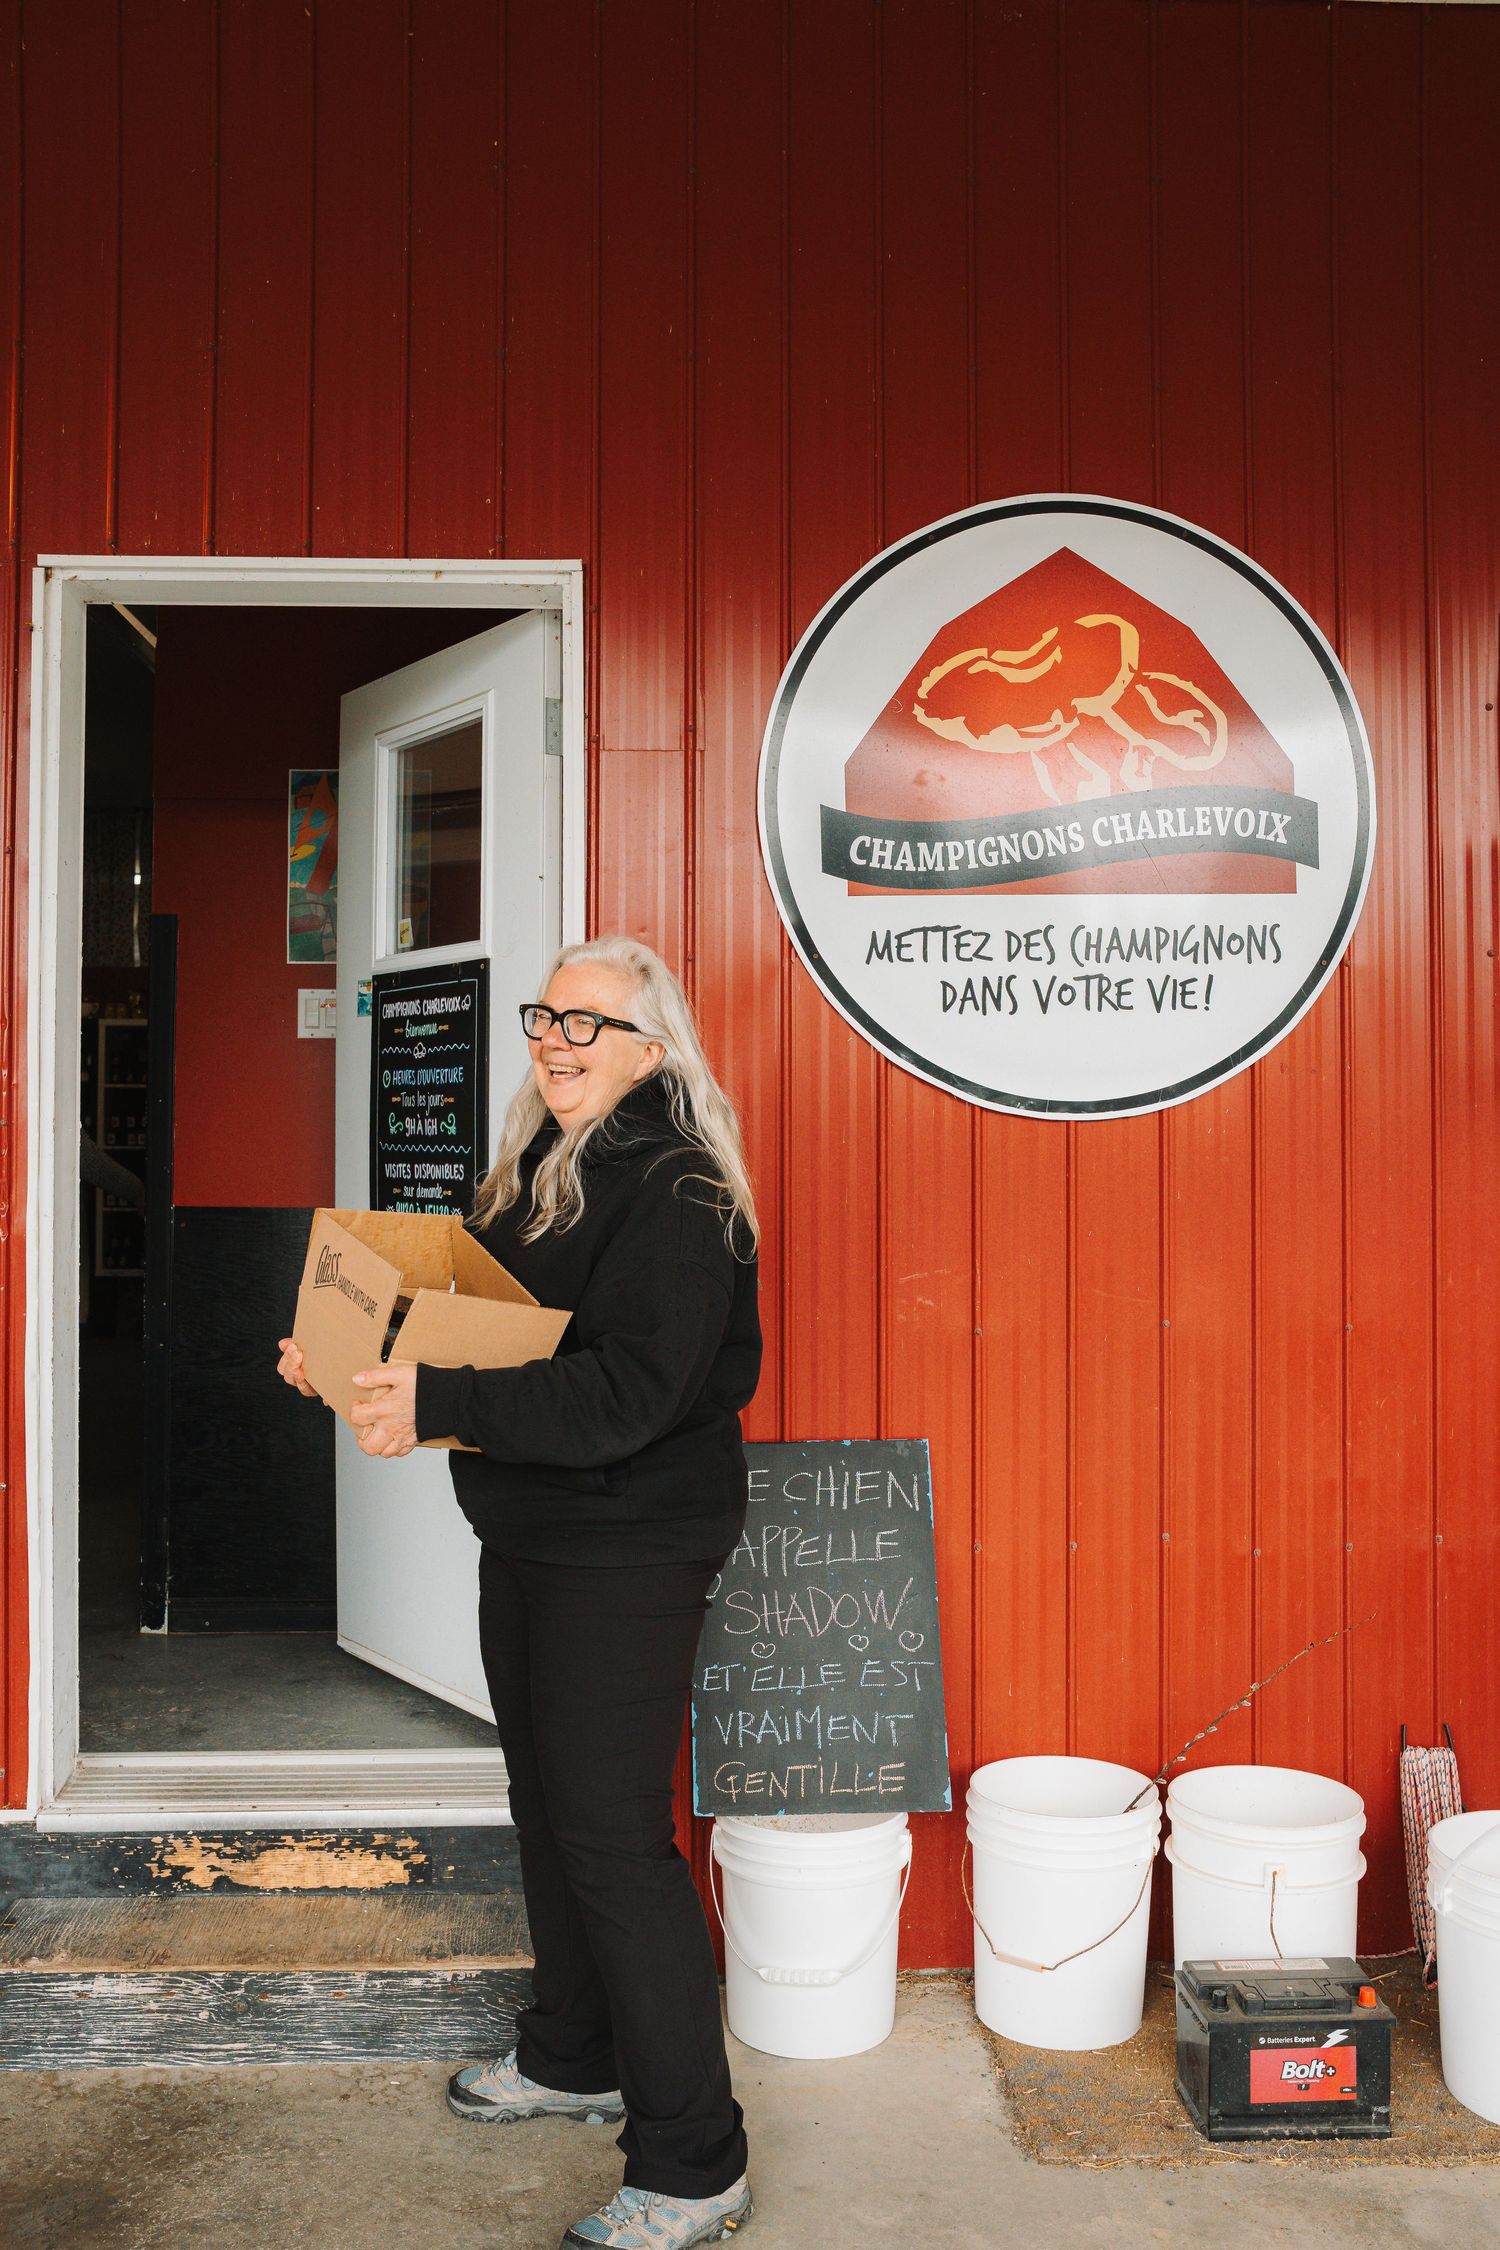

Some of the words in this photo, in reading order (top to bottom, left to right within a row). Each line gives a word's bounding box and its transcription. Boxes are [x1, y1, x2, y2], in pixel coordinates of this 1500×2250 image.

[848, 821, 1085, 872] CHAMPIGNONS
[1091, 806, 1292, 847] CHARLEVOIX
[865, 924, 994, 965] METTEZ
[1005, 924, 1057, 965] DES
[1069, 923, 1283, 967] CHAMPIGNONS
[382, 1000, 421, 1019] CHAMPIGNONS
[422, 996, 461, 1016] CHARLEVOIX
[939, 973, 1018, 1015] DANS
[1032, 973, 1136, 1014] VOTRE
[1146, 973, 1214, 1013] VIE!
[392, 1069, 416, 1086] HEURES
[417, 1066, 464, 1086] D'OUVERTURE
[400, 1091, 416, 1107] Tous
[417, 1090, 426, 1107] les
[425, 1091, 445, 1117] jours
[405, 1116, 416, 1137] 9H
[424, 1117, 438, 1136] 16H
[384, 1163, 412, 1179] VISITES
[414, 1162, 465, 1180] DISPONIBLES
[402, 1185, 415, 1197] sur
[415, 1182, 443, 1199] demande
[314, 1244, 342, 1285] Glass
[363, 1295, 379, 1319] CARE
[747, 1469, 771, 1502] E
[782, 1460, 920, 1512] CHIEN
[724, 1577, 914, 1637] SHADOW
[702, 1663, 741, 1691] ET
[751, 1663, 846, 1692] ELLE
[860, 1660, 935, 1691] EST
[1294, 2036, 1316, 2044] Expert
